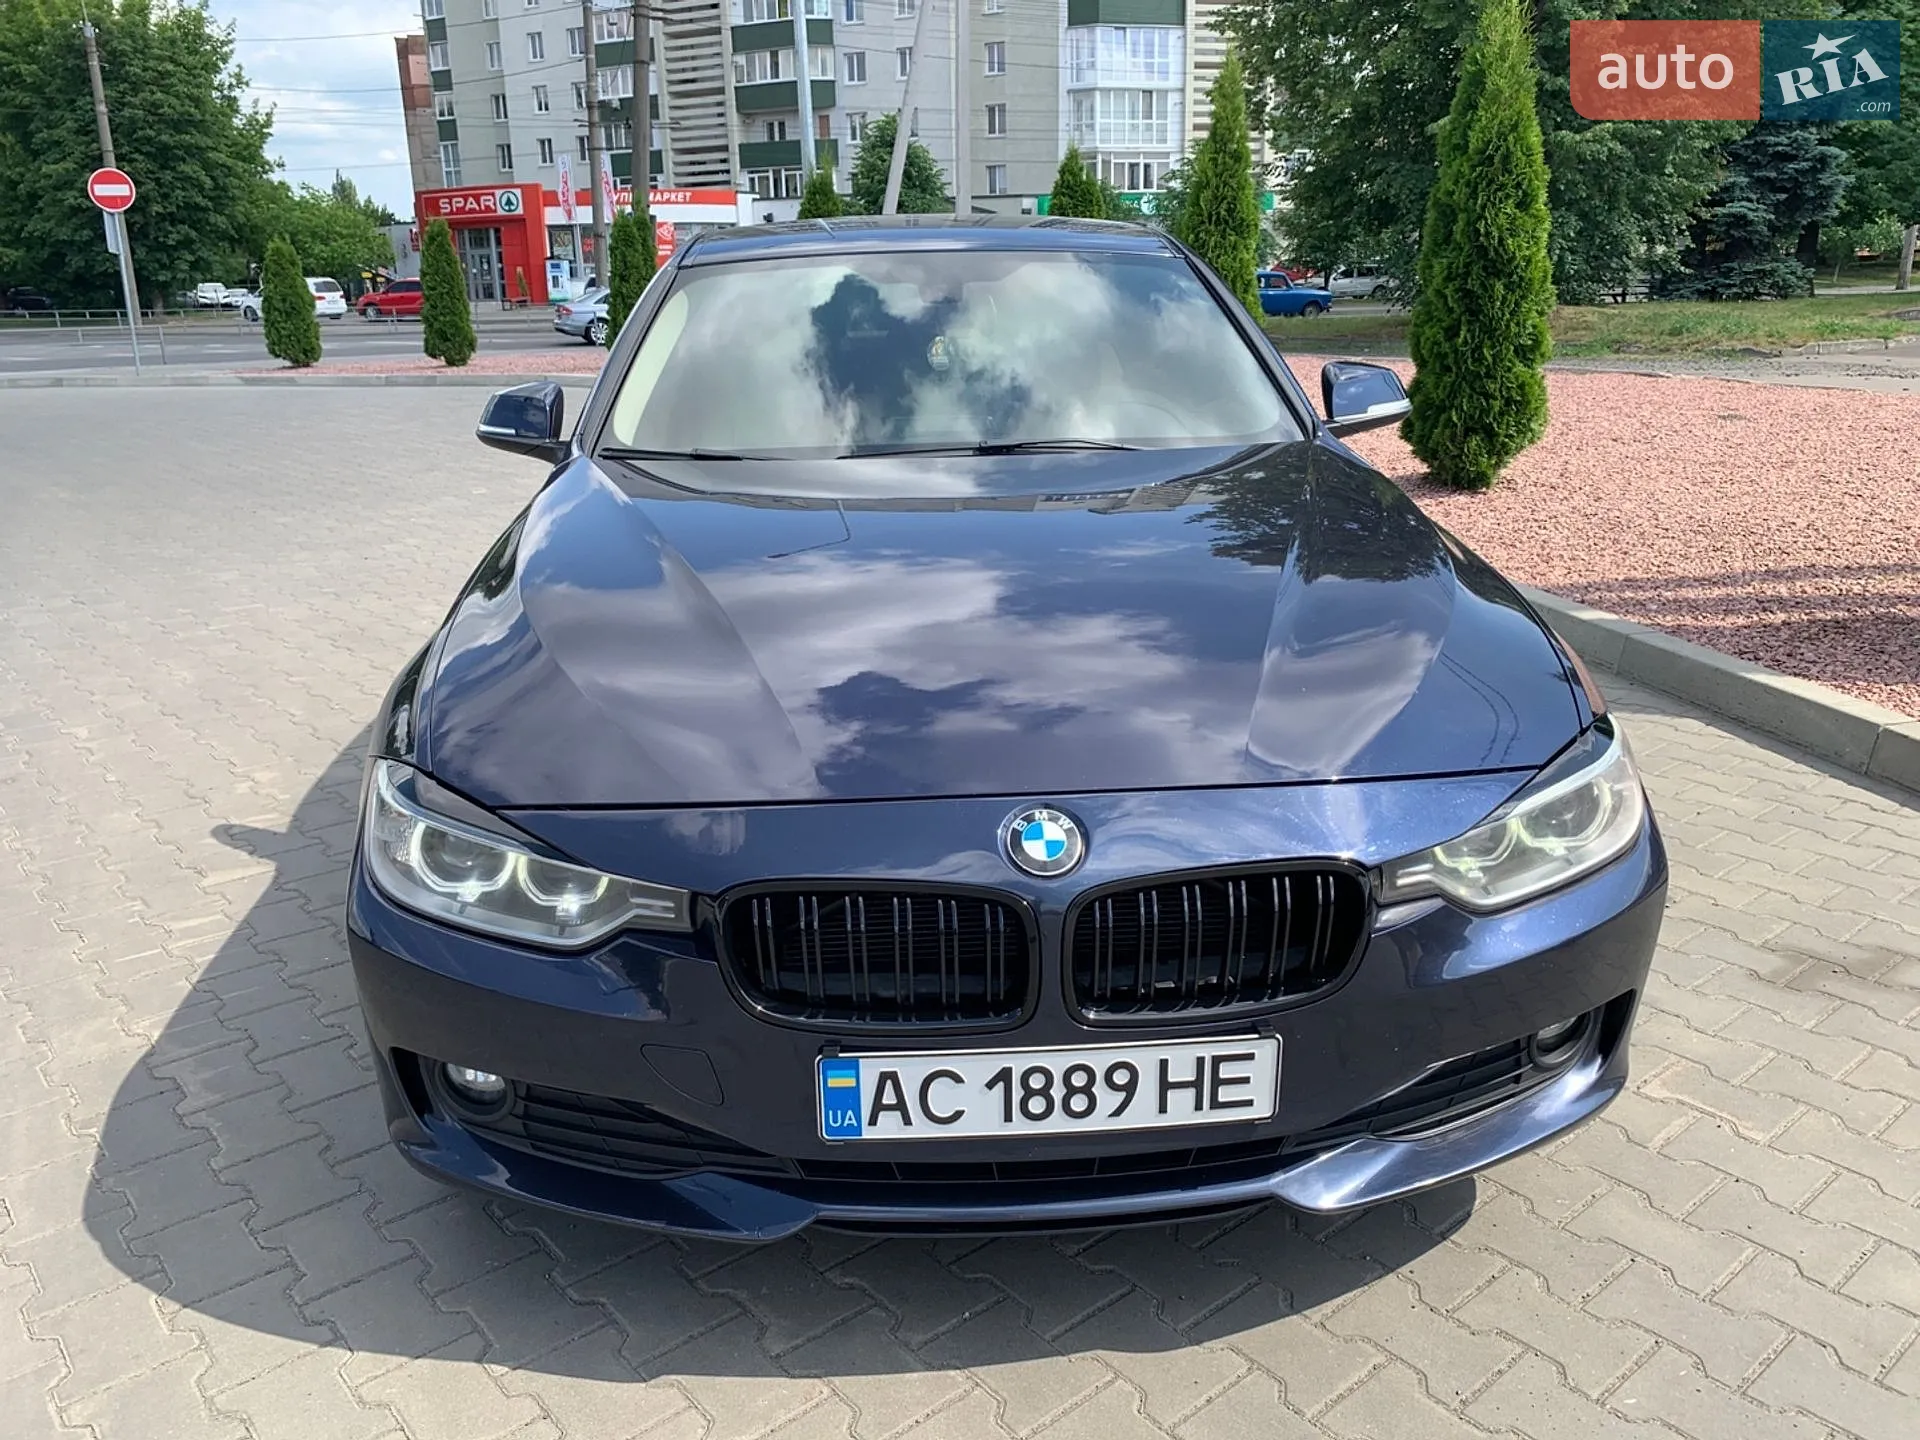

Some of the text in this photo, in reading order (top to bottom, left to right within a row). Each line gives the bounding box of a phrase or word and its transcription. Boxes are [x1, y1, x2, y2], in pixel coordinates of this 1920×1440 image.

[439, 195, 496, 213] SPAR
[1012, 810, 1074, 832] BMW
[867, 1051, 1257, 1127] AC 1889 HE
[828, 1109, 858, 1127] UA
